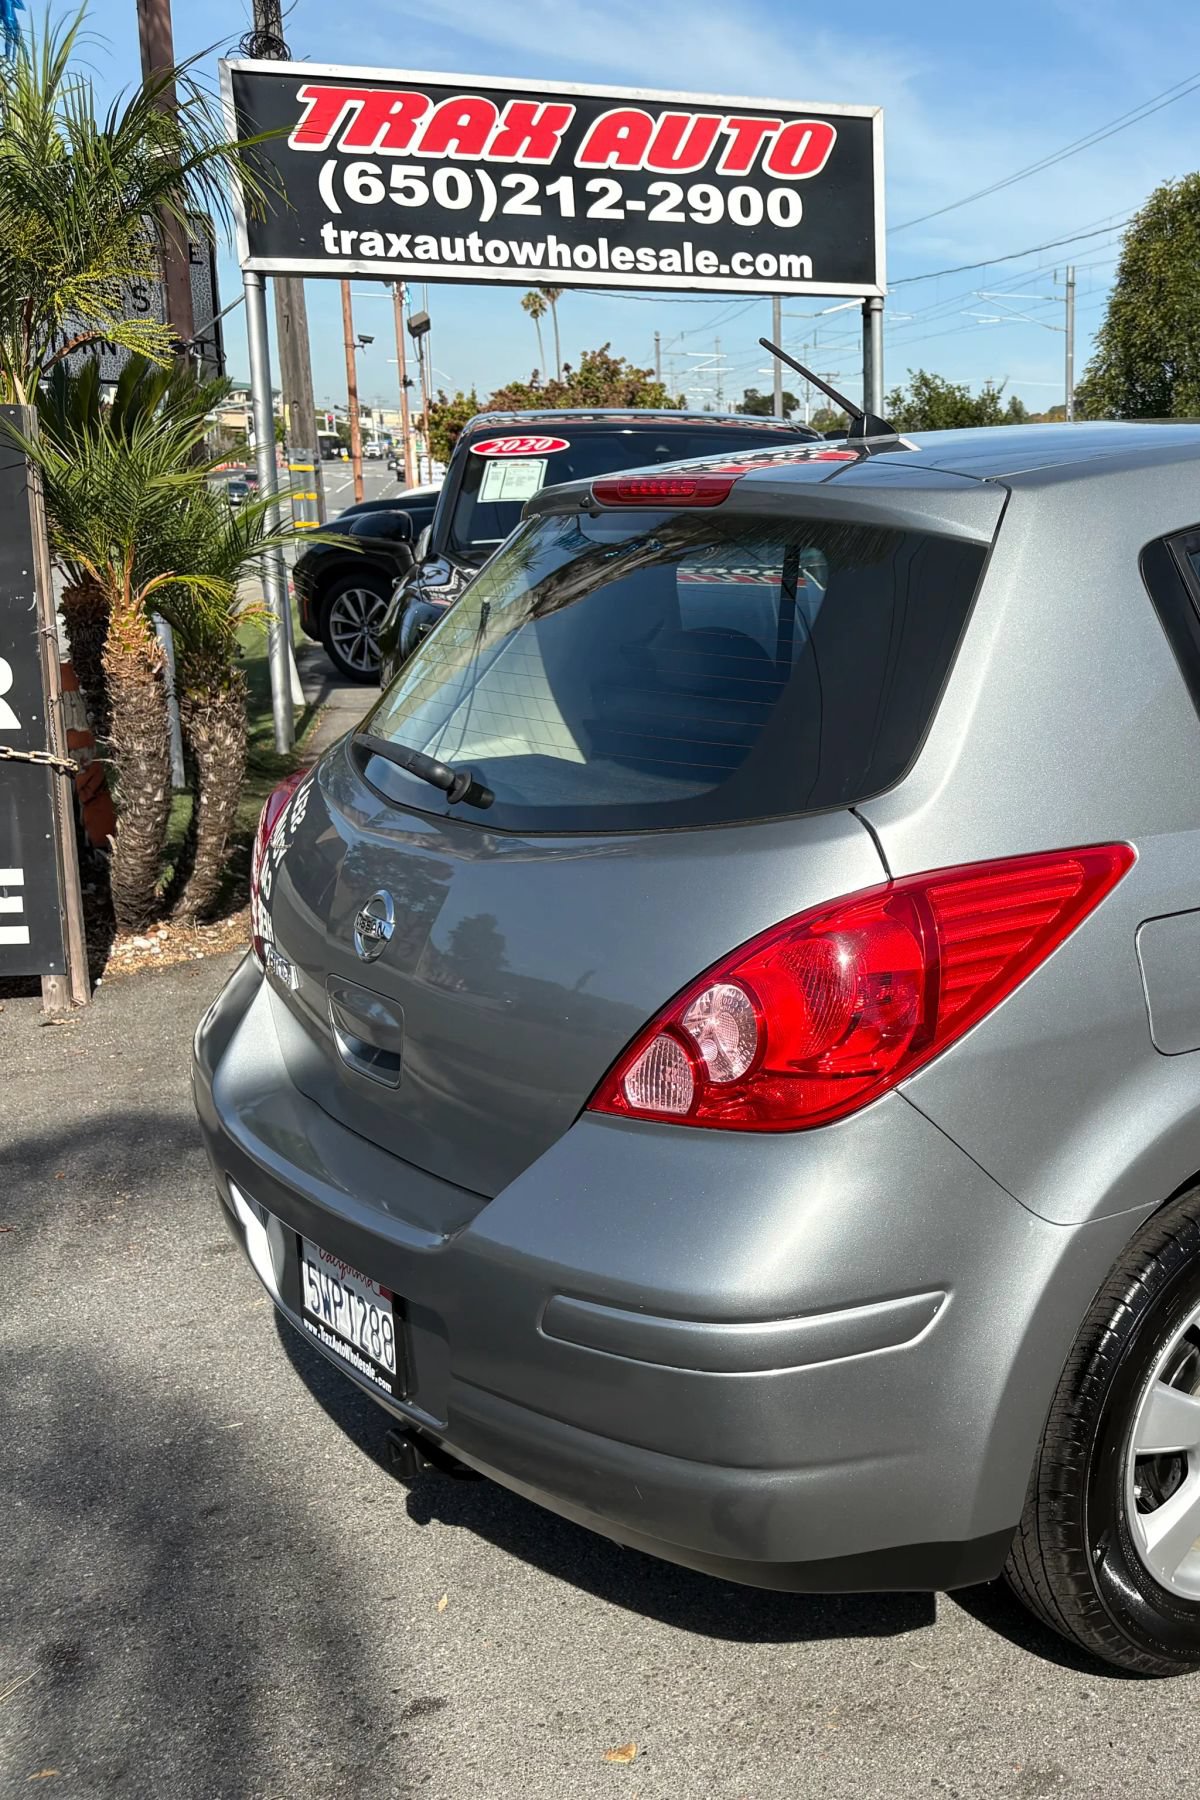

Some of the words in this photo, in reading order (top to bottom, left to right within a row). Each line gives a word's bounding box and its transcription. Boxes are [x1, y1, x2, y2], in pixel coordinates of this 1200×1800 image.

[288, 84, 577, 165] TRAX
[574, 107, 837, 180] AUTO
[318, 159, 803, 228] (650)212-2900
[320, 221, 813, 279] traxautowholesale.com
[484, 439, 554, 453] 2020
[307, 1259, 394, 1370] 5WPT288
